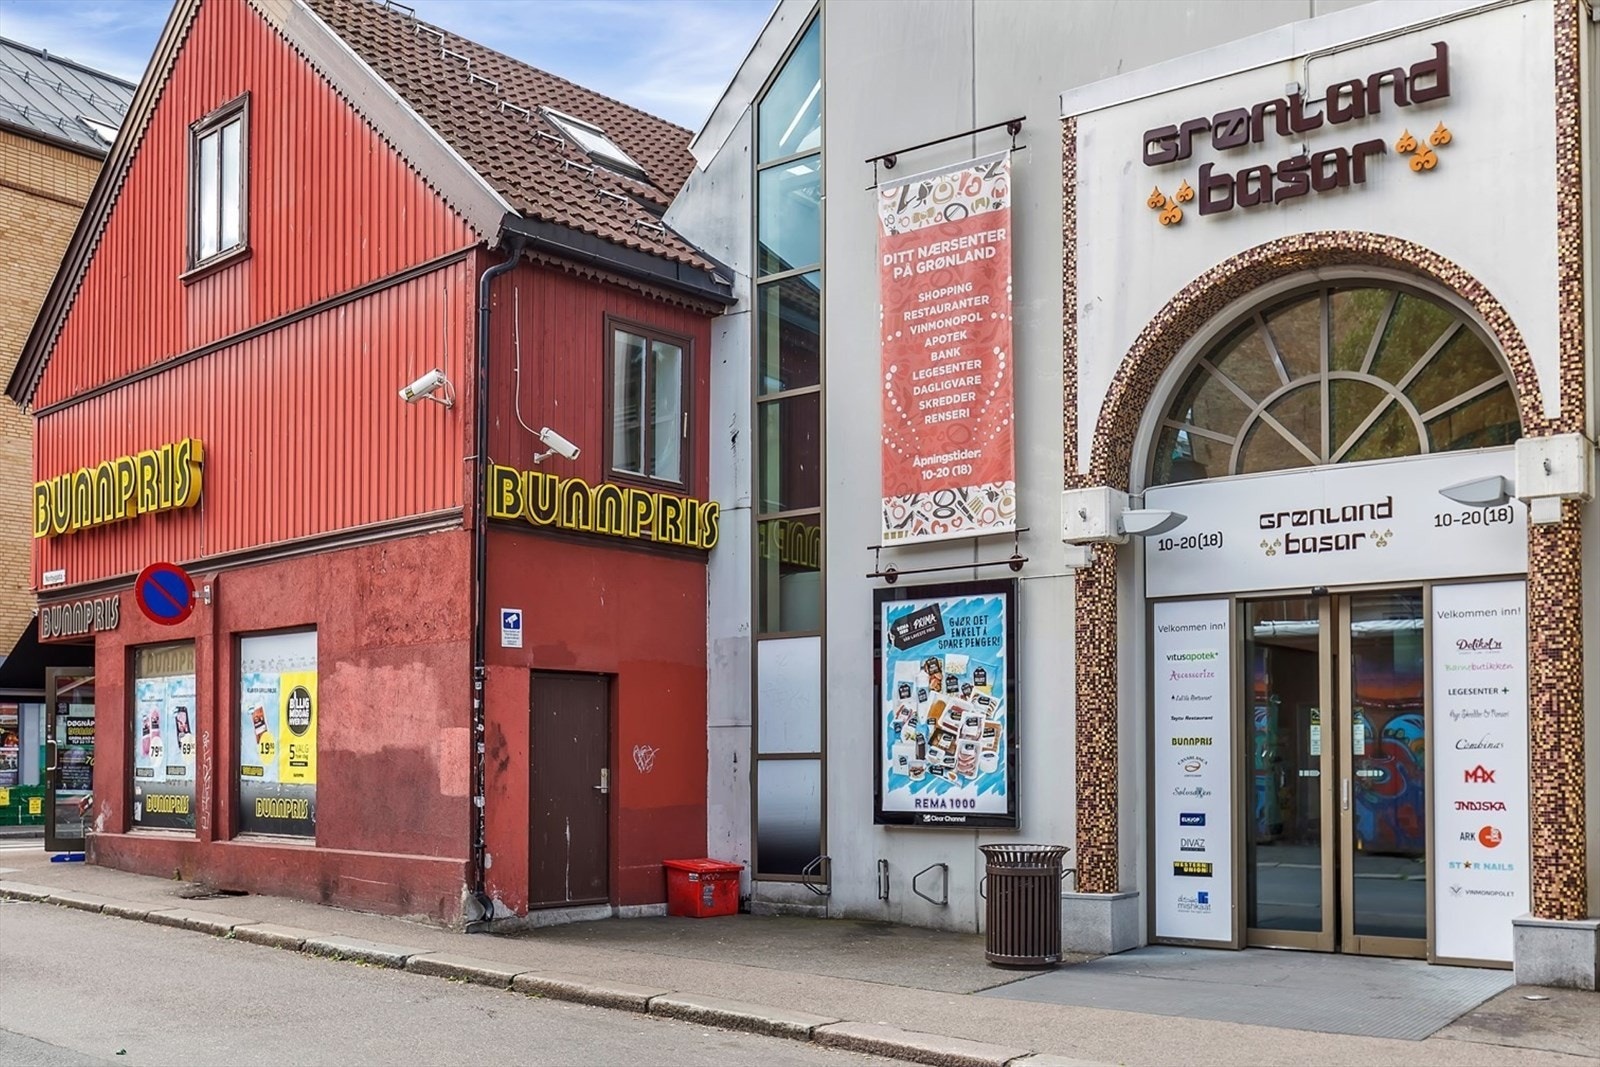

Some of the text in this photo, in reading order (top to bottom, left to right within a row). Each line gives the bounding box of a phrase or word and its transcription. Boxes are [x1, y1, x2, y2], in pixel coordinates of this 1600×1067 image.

[1198, 139, 1387, 216] basar
[883, 228, 1007, 267] DITT NÆRSENTER
[894, 246, 996, 279] PÅ GRØNLAND
[918, 282, 973, 302] SHOPPING
[903, 295, 990, 321] RESTAURANTER
[909, 312, 983, 335] VINMONOPOL
[924, 330, 967, 347] APOTEK
[930, 348, 961, 362] BANK
[912, 359, 982, 381] LEGESENTER
[913, 375, 982, 396] DAGLIGVARE
[918, 392, 976, 410] SKREDDER
[924, 408, 970, 425] RENSERI
[912, 449, 982, 469] Åpningstider:
[921, 464, 972, 480] 10-20 (18)
[34, 437, 202, 538] BUNNPRIS
[487, 464, 720, 549] BUNNPRIS
[1284, 532, 1366, 555] basar
[42, 595, 120, 638] BUNNPRIS
[973, 615, 989, 626] DET
[1437, 607, 1522, 619] Velkommen inn!
[951, 627, 980, 638] ENKELT
[1158, 622, 1226, 633] Velkommen inn!
[938, 636, 1001, 650] SPARE PENGER!
[1169, 669, 1215, 681] Accessorize
[289, 691, 310, 709] BILLIG
[1448, 687, 1499, 696] LEGESENTER
[183, 743, 191, 754] 69
[260, 742, 269, 755] 19
[1171, 737, 1213, 746] BUNNPRIS
[151, 746, 159, 757] 79
[289, 744, 295, 760] 5
[1464, 764, 1496, 783] MAX
[146, 793, 190, 814] BUNNPRIS
[255, 797, 308, 819] BUNNPRIS
[915, 798, 976, 809] REMA 1000
[931, 814, 966, 823] Clear Channel
[1459, 831, 1476, 841] ARK
[1483, 863, 1514, 871] NAILS
